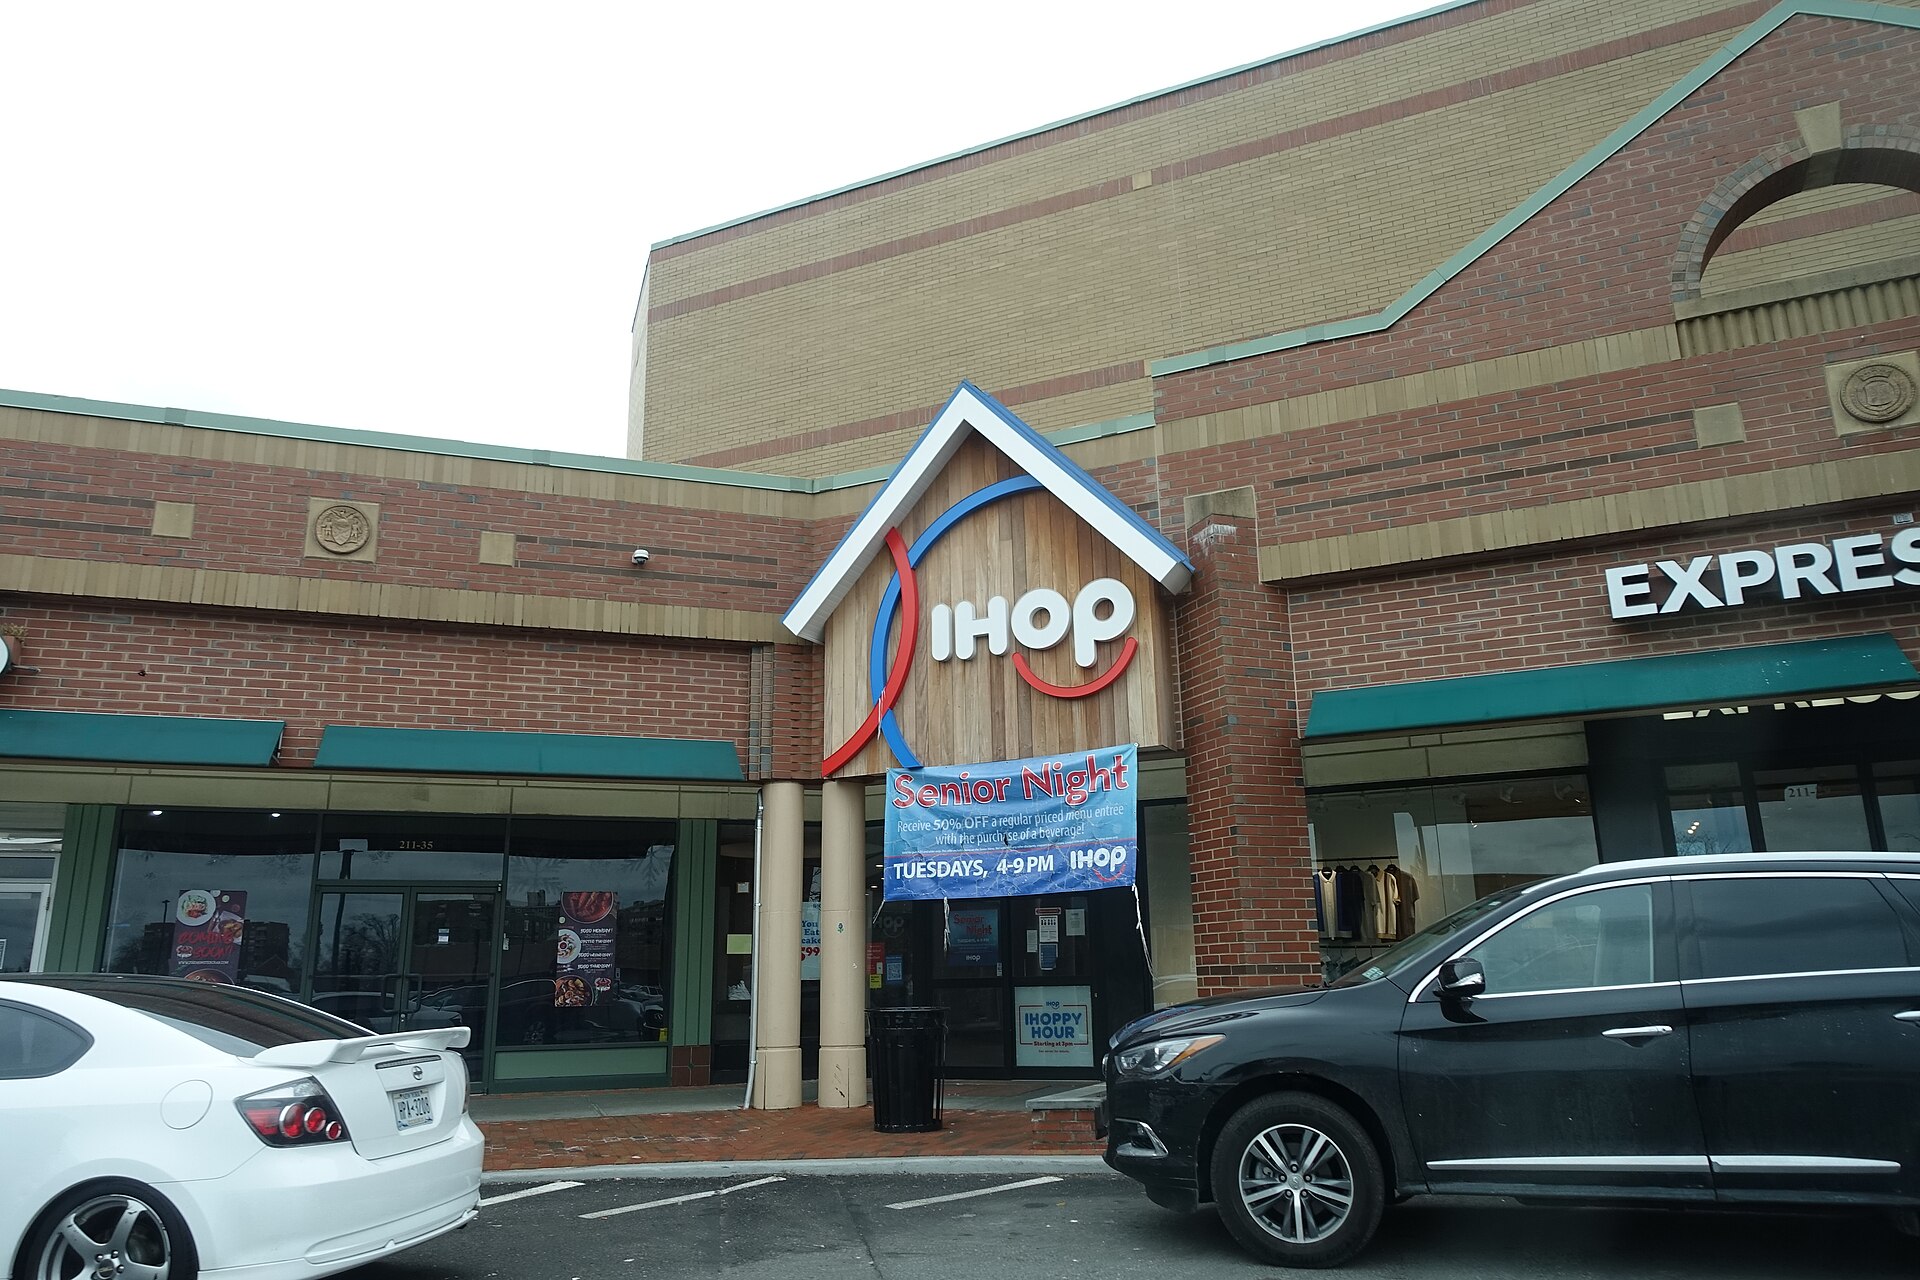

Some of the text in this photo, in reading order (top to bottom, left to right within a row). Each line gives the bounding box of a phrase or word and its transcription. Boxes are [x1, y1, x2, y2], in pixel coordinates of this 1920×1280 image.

[931, 577, 1136, 668] IHOP
[892, 754, 1129, 809] Senior Night
[897, 820, 931, 833] Receive
[933, 818, 962, 831] 50%
[964, 815, 989, 829] OFF
[991, 818, 998, 827] a
[999, 813, 1032, 828] regular
[1034, 809, 1064, 827] priced
[1065, 808, 1092, 821] menu
[400, 840, 433, 850] 211-35
[935, 833, 957, 845] with
[959, 832, 975, 844] the
[1020, 827, 1030, 840] of
[1031, 830, 1037, 839] a
[1039, 823, 1085, 840] beverage!
[893, 854, 1054, 880] TUESDAYS, 4-9 PM
[1070, 845, 1127, 872] IHOP
[802, 920, 819, 928] You
[804, 928, 820, 936] Eat
[1025, 1013, 1081, 1025] IHOPPY
[1032, 1026, 1074, 1038] HOUR
